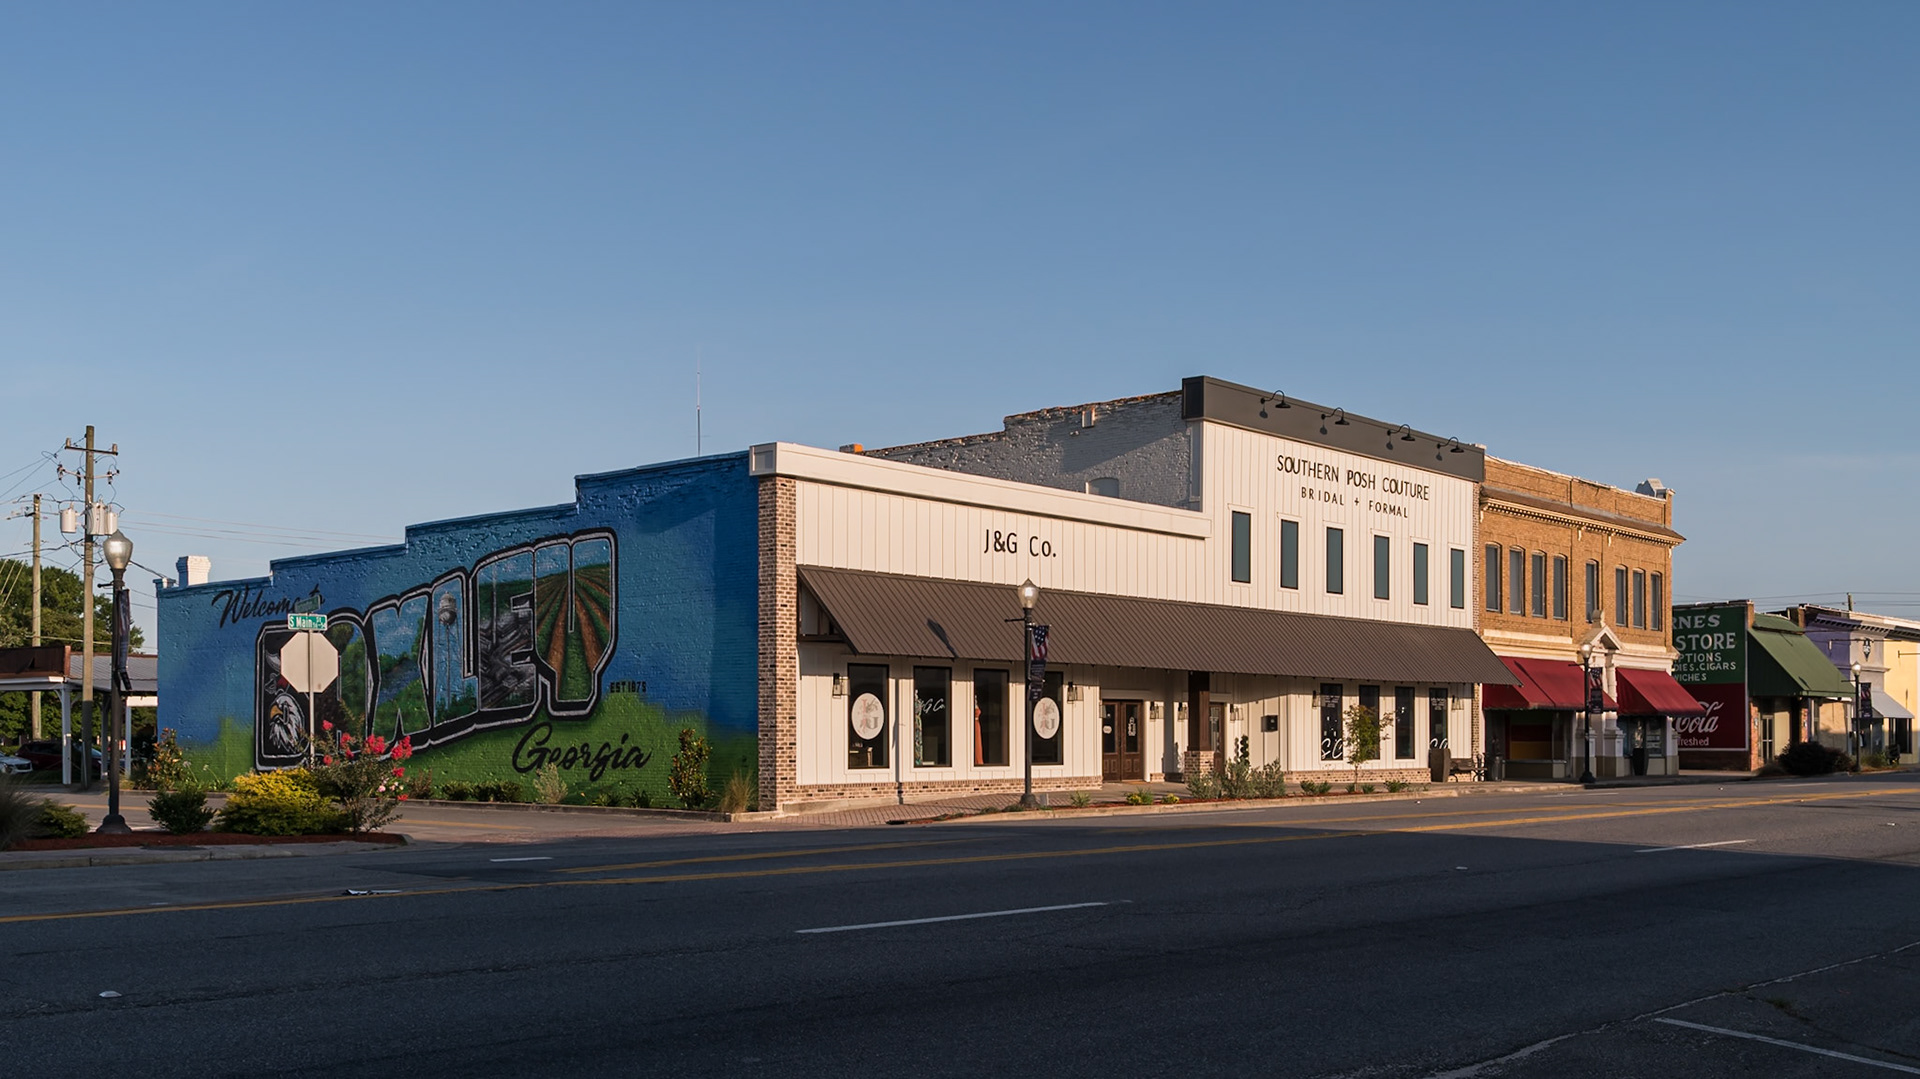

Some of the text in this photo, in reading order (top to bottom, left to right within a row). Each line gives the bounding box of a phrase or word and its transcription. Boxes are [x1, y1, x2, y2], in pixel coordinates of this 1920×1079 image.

[1277, 455, 1429, 501] SOUTHERN POSH COUTURE
[1301, 486, 1344, 506] BRIDAL
[1369, 500, 1408, 518] FORMAL
[984, 529, 1057, 558] J&G Co.
[289, 616, 295, 628] S
[296, 616, 313, 628] Main
[1675, 632, 1736, 652] STORE
[610, 681, 626, 693] EST
[512, 722, 652, 782] Georgia
